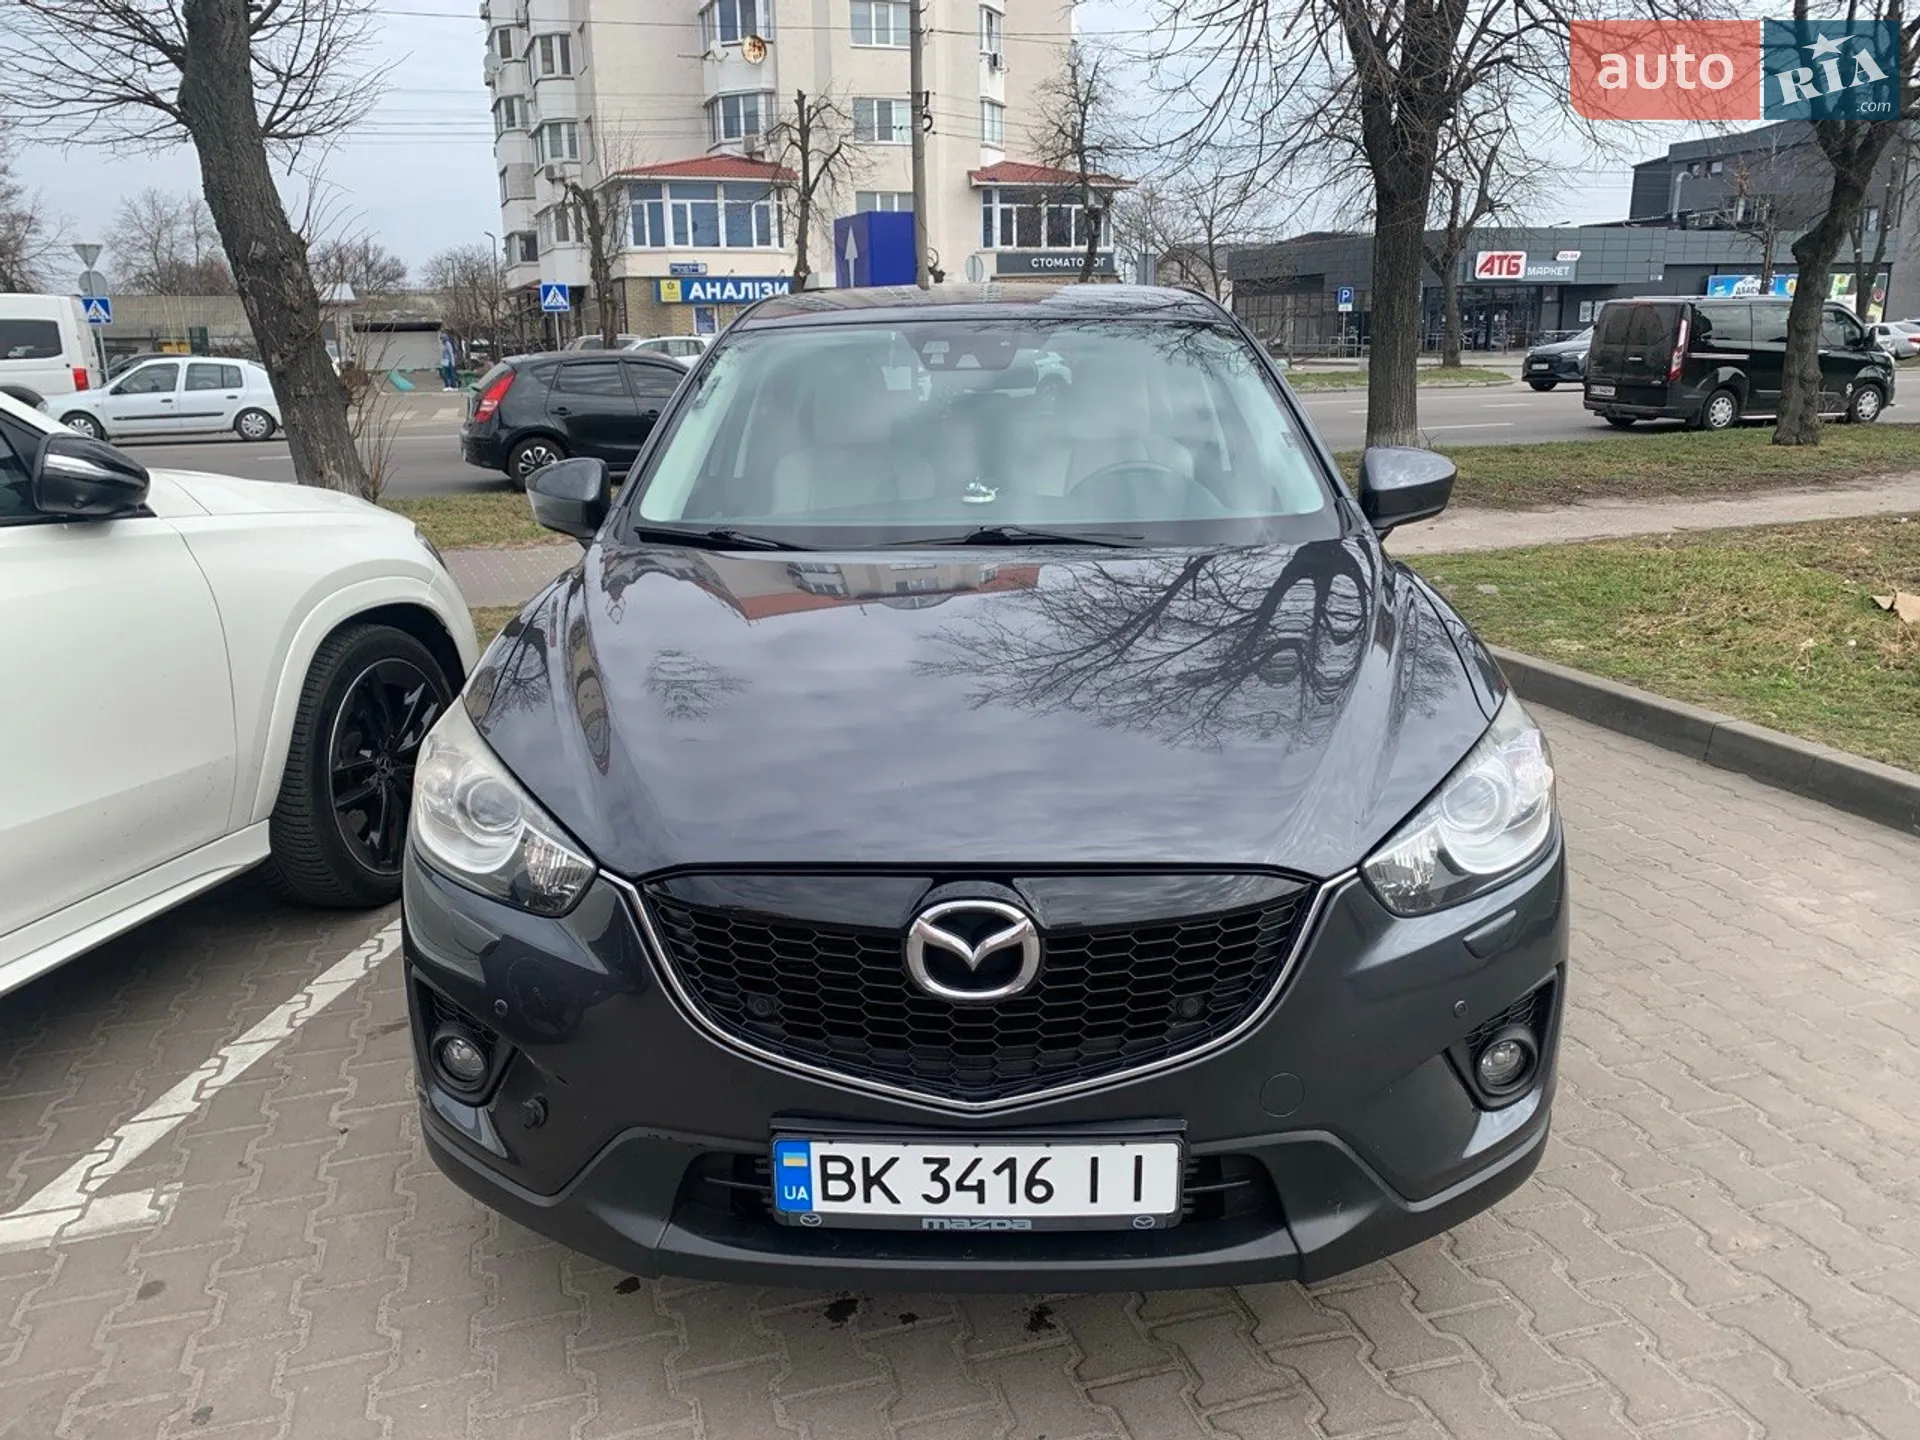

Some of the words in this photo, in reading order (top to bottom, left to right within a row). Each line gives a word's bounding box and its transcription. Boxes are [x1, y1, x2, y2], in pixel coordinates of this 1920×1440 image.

[1031, 257, 1106, 268] СТОМАТООГ
[1527, 266, 1570, 276] МАРКЕТ
[689, 282, 789, 300] АНАЛІЗИ
[819, 1155, 901, 1204] BK
[921, 1157, 1055, 1204] 3416
[784, 1186, 809, 1201] UA
